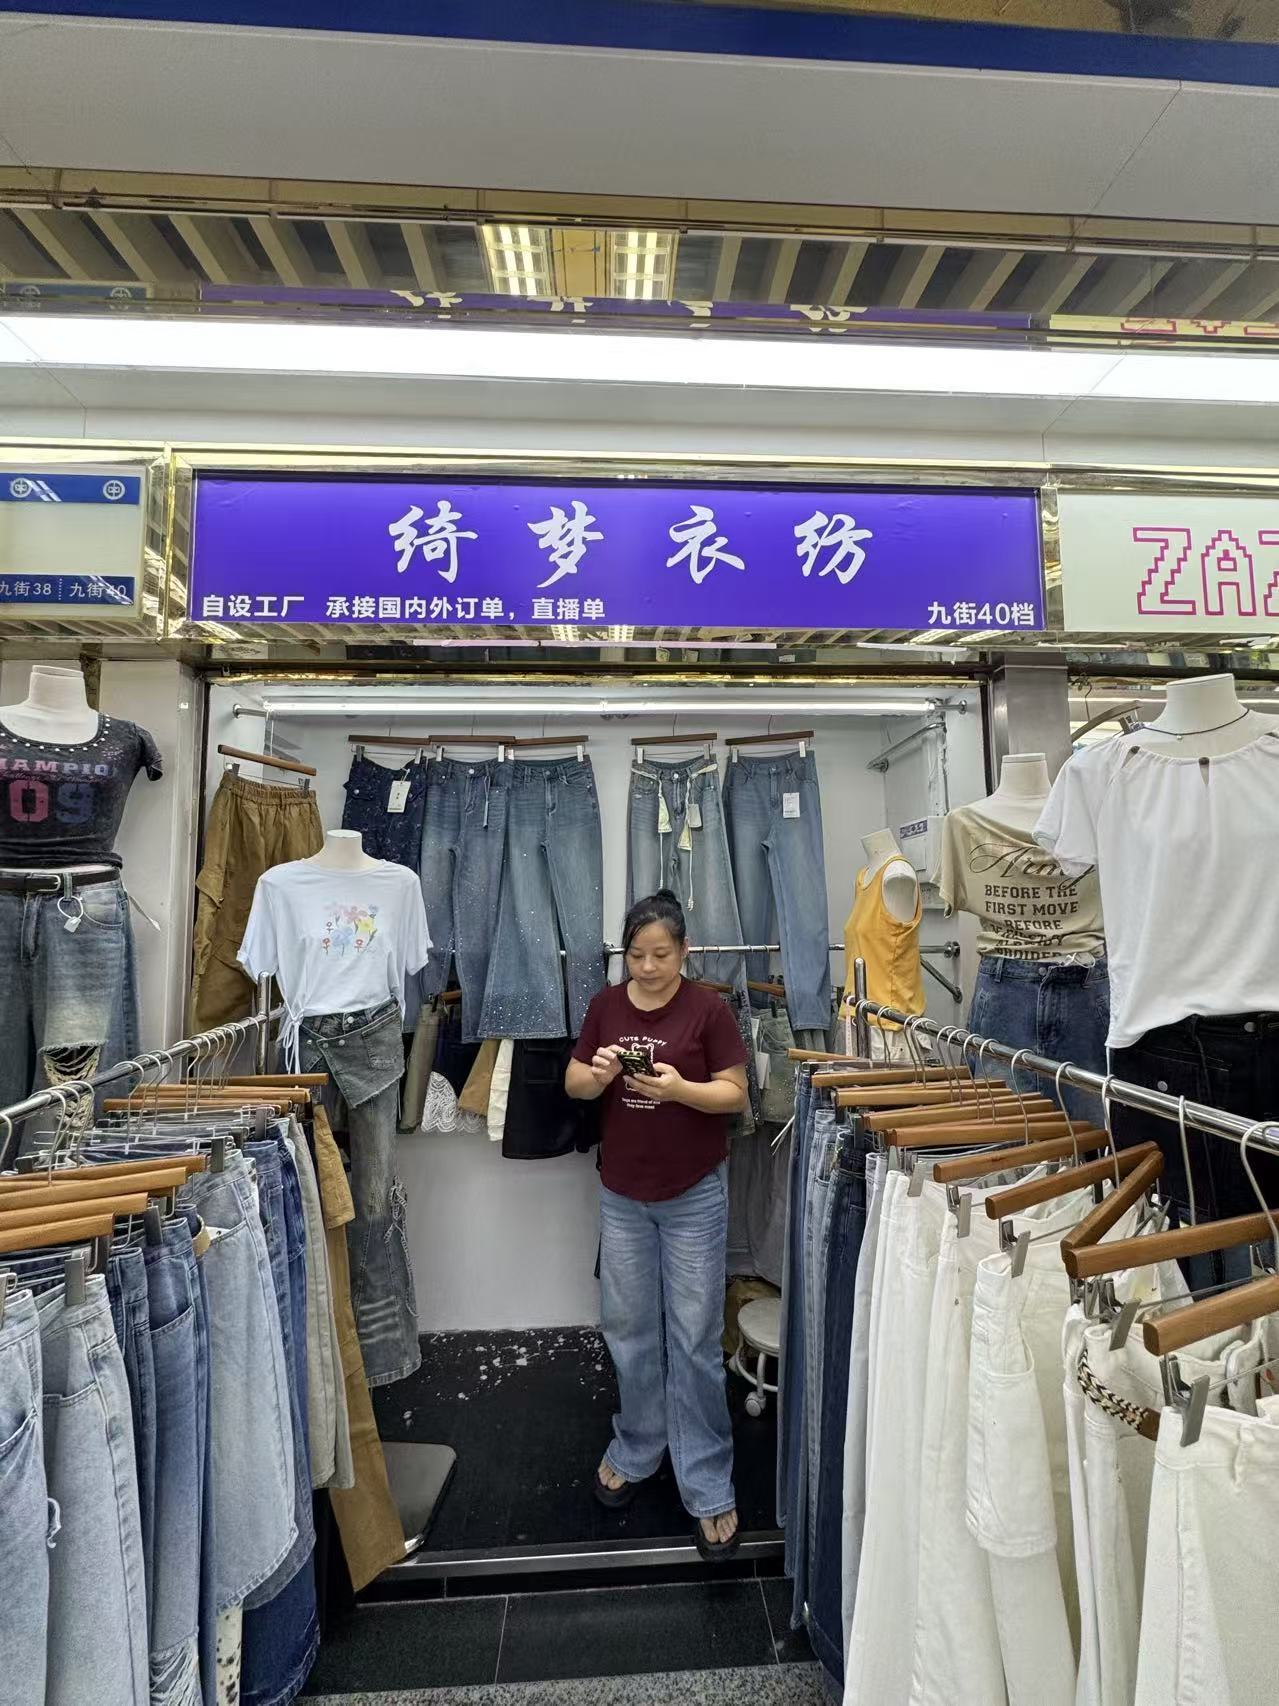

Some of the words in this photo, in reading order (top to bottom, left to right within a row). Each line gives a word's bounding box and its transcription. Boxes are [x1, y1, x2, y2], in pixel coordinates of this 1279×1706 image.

[388, 500, 873, 588] 绮梦衣纺
[202, 595, 305, 618] 自设工厂
[927, 601, 1035, 626] 九街40档
[984, 884, 1041, 899] BEFORE
[1045, 885, 1078, 898] THE
[984, 900, 1026, 916] FIRST
[1032, 901, 1079, 916] MOVE
[642, 1036, 667, 1046] PUPPY
